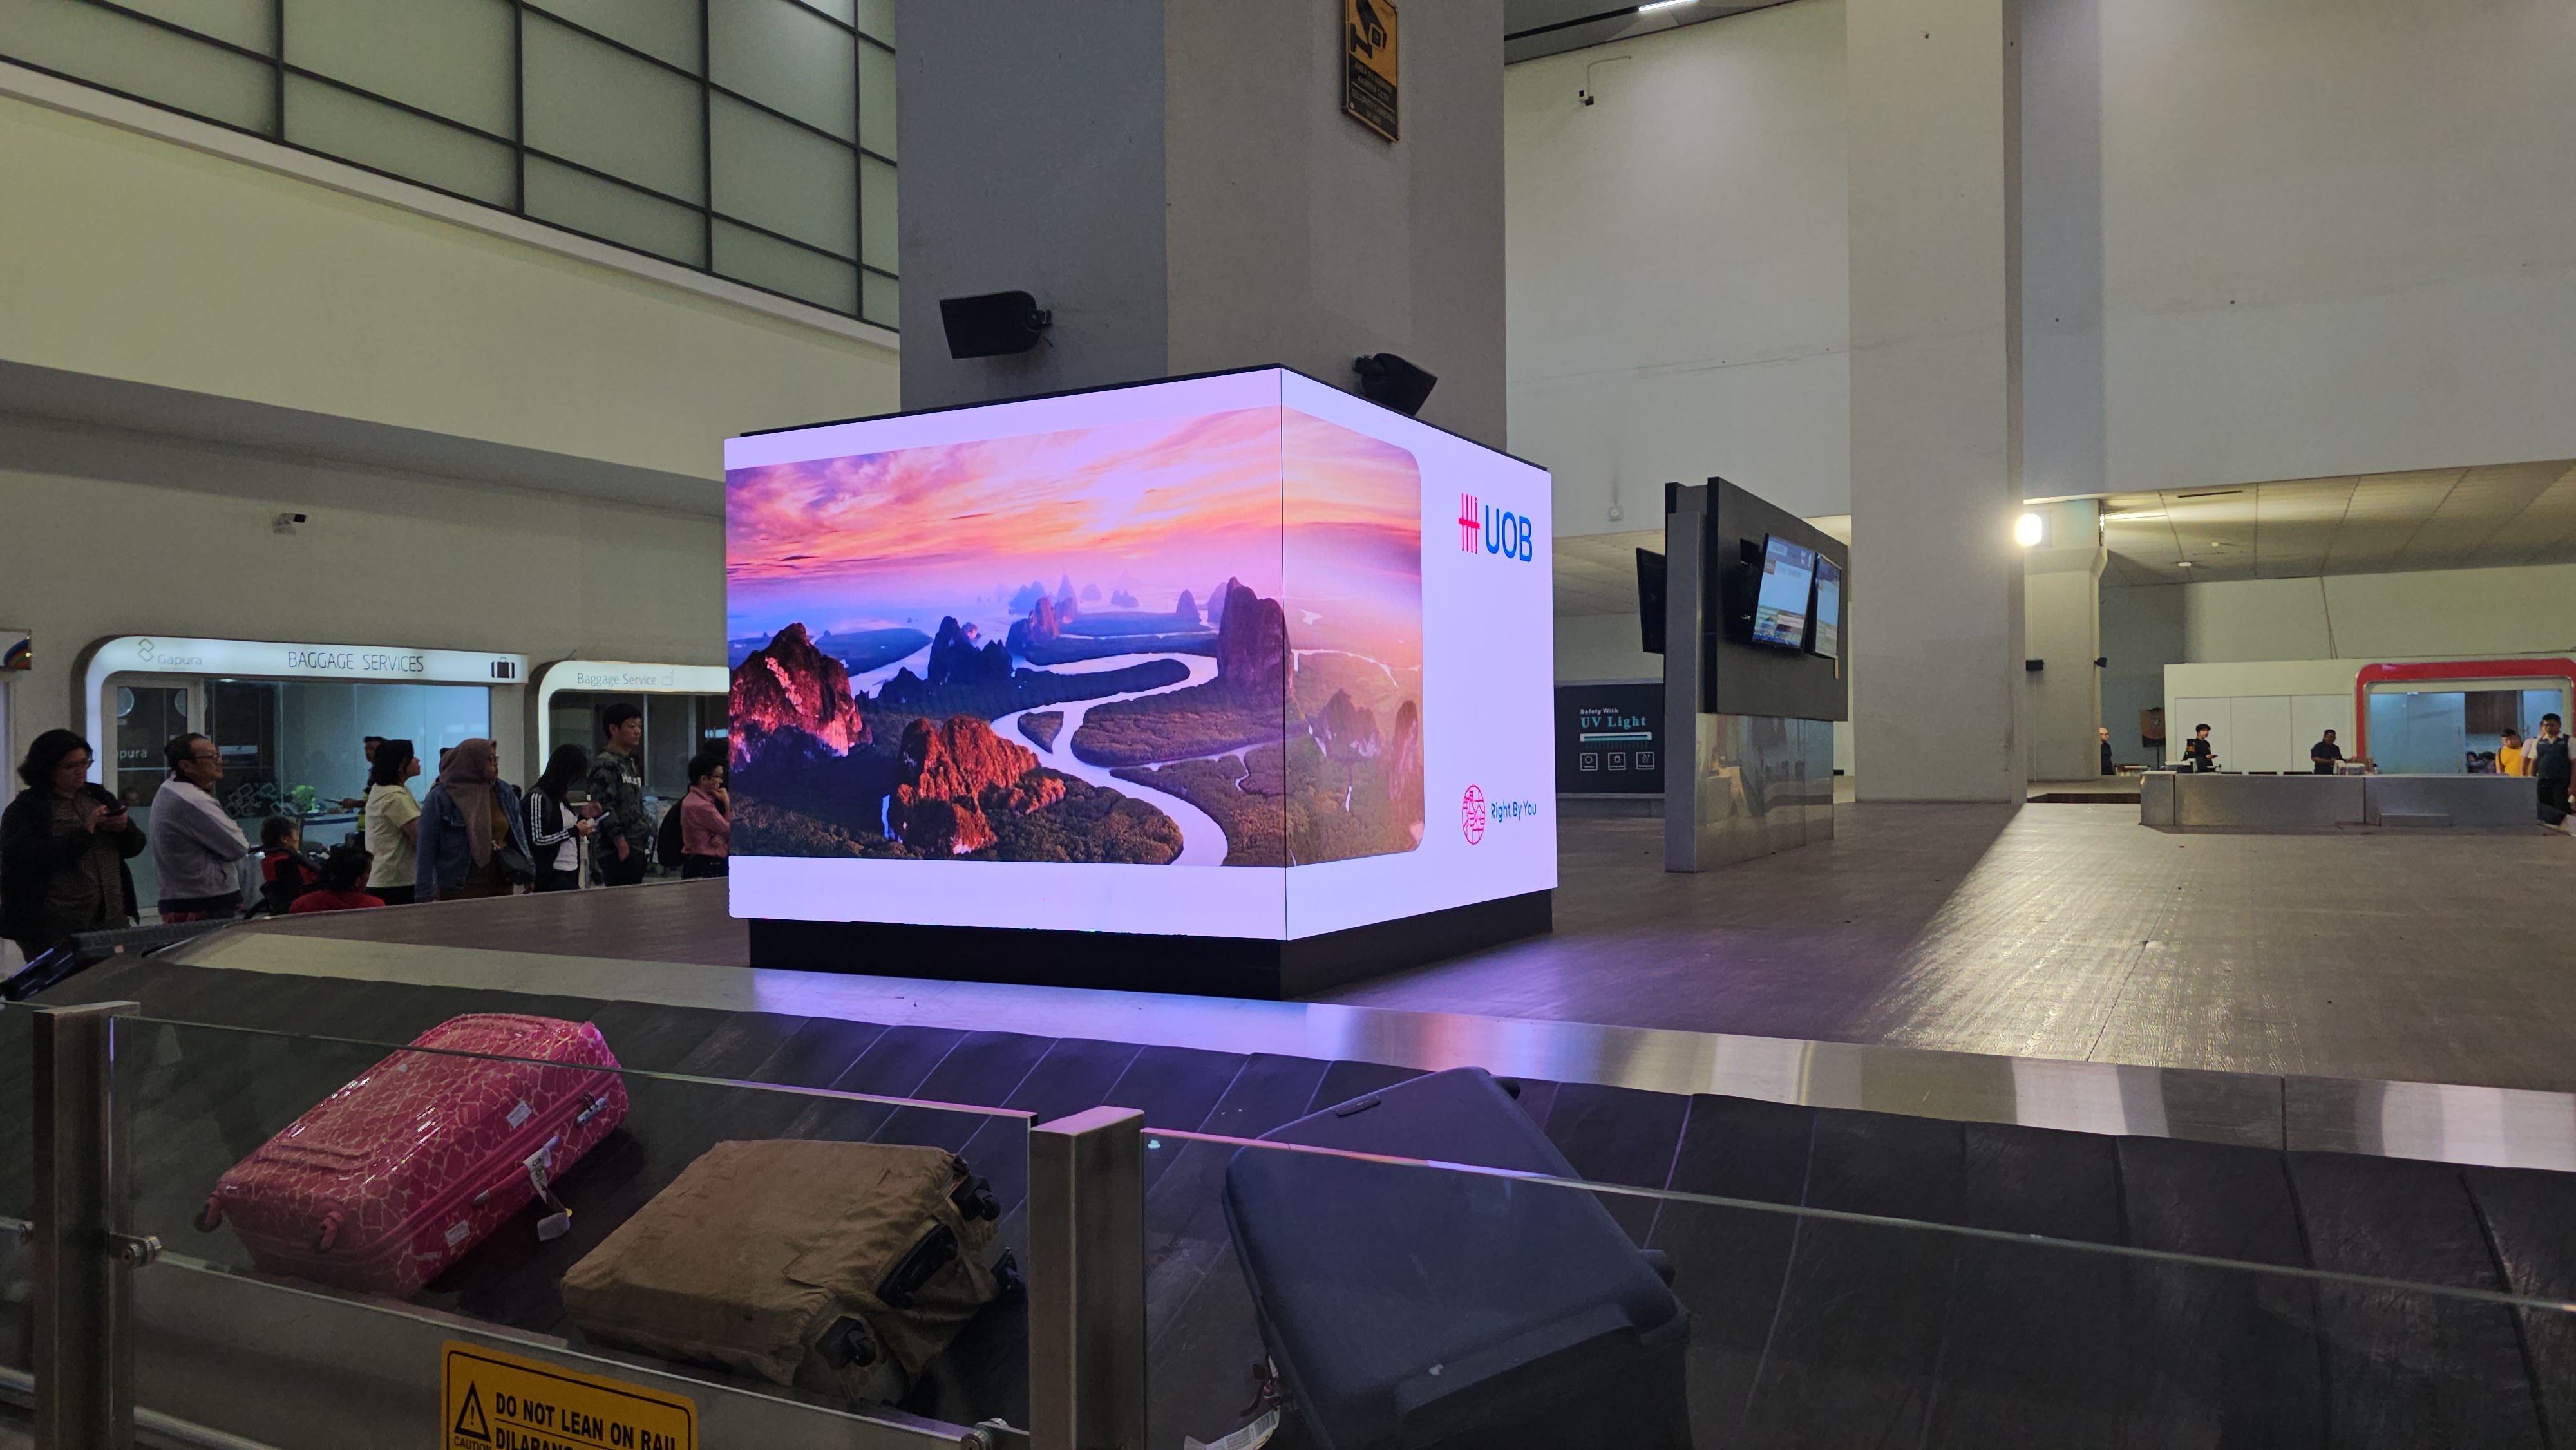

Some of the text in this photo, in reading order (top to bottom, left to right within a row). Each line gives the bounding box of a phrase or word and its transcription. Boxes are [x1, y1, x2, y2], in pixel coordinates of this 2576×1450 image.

[1485, 504, 1533, 563] UOB
[158, 654, 202, 666] Gapura
[288, 651, 424, 672] BAGGAGE SERVICES
[577, 673, 657, 687] Baggage Service
[1580, 715, 1646, 730] UV Light
[118, 748, 147, 760] pura
[1491, 800, 1537, 823] Right By You
[496, 1391, 516, 1417] DO
[524, 1399, 555, 1427] NOT
[562, 1409, 603, 1441] LEAN
[611, 1422, 634, 1448] ON
[495, 1427, 573, 1450] DILAR
